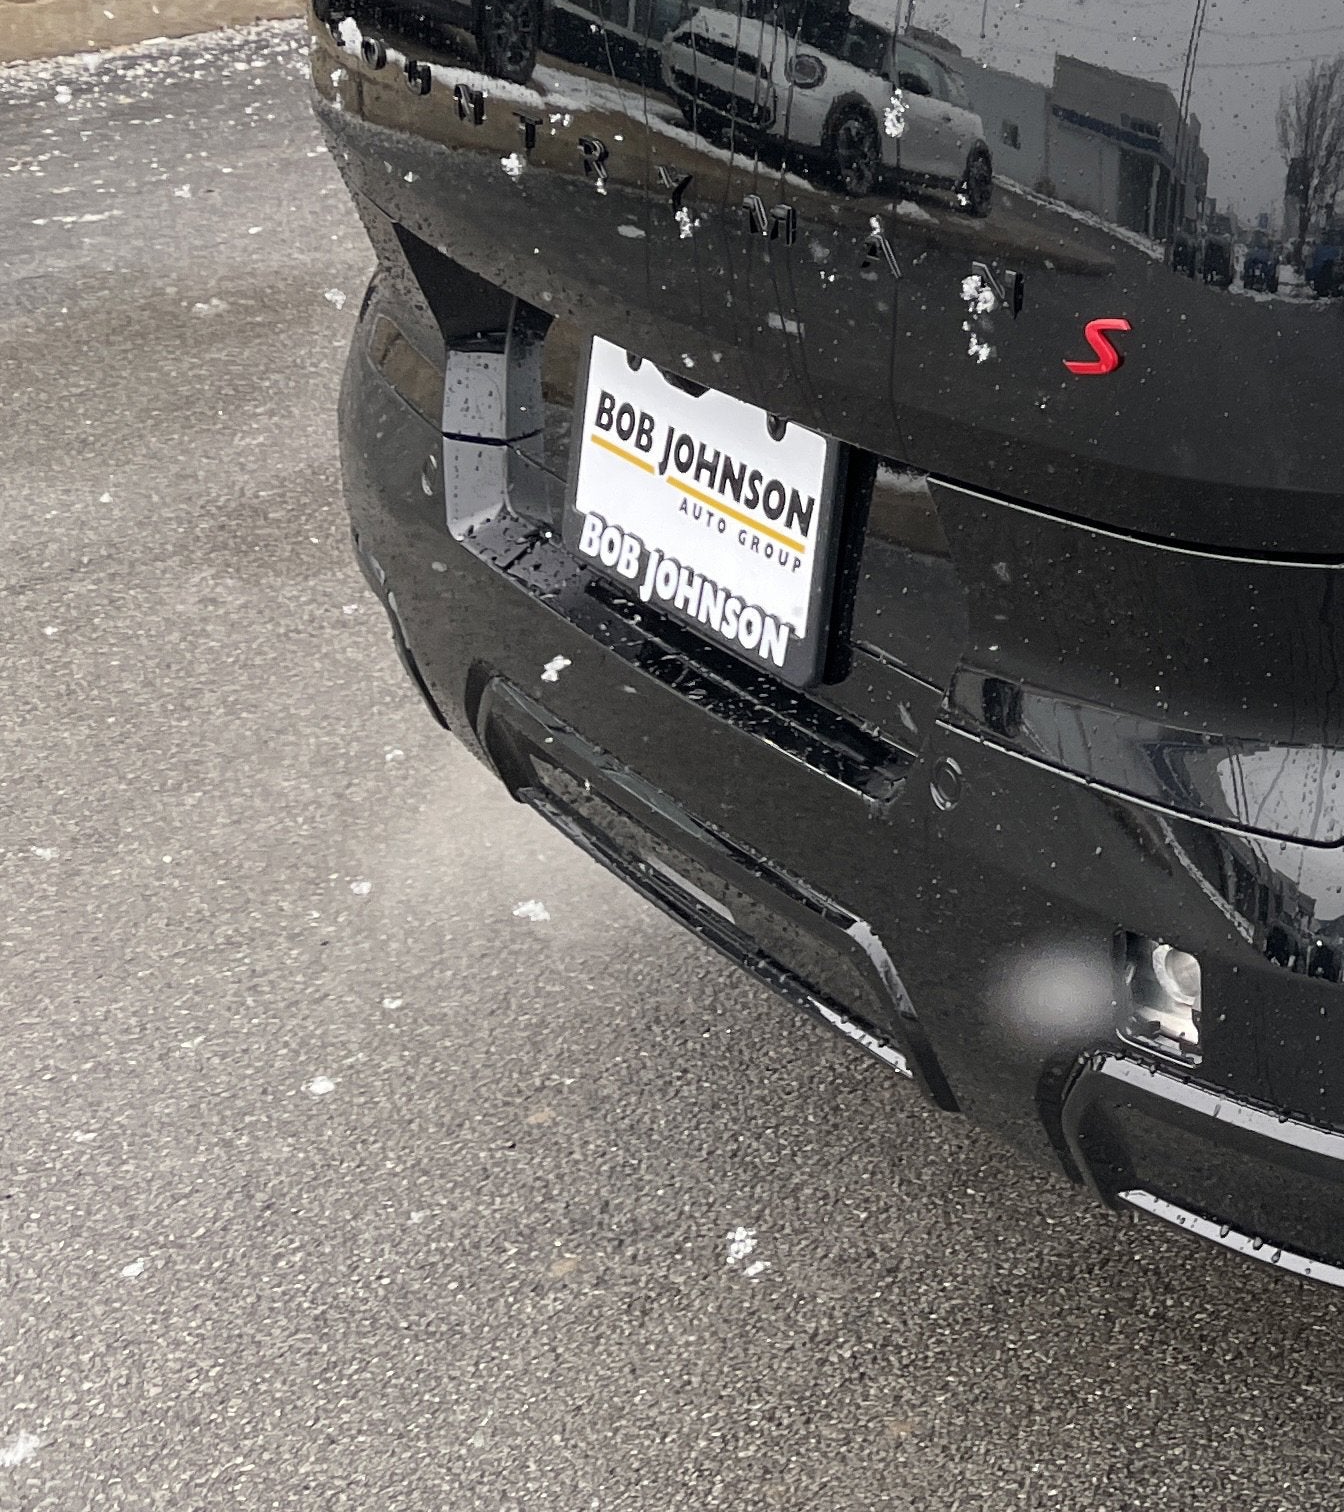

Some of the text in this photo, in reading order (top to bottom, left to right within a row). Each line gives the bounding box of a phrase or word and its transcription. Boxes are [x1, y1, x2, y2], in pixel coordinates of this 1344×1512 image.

[1062, 318, 1132, 376] S
[594, 389, 816, 538] BOB JOHNSON
[578, 511, 790, 669] BOB JOHNSON
[678, 496, 802, 574] AUTO GROUP
